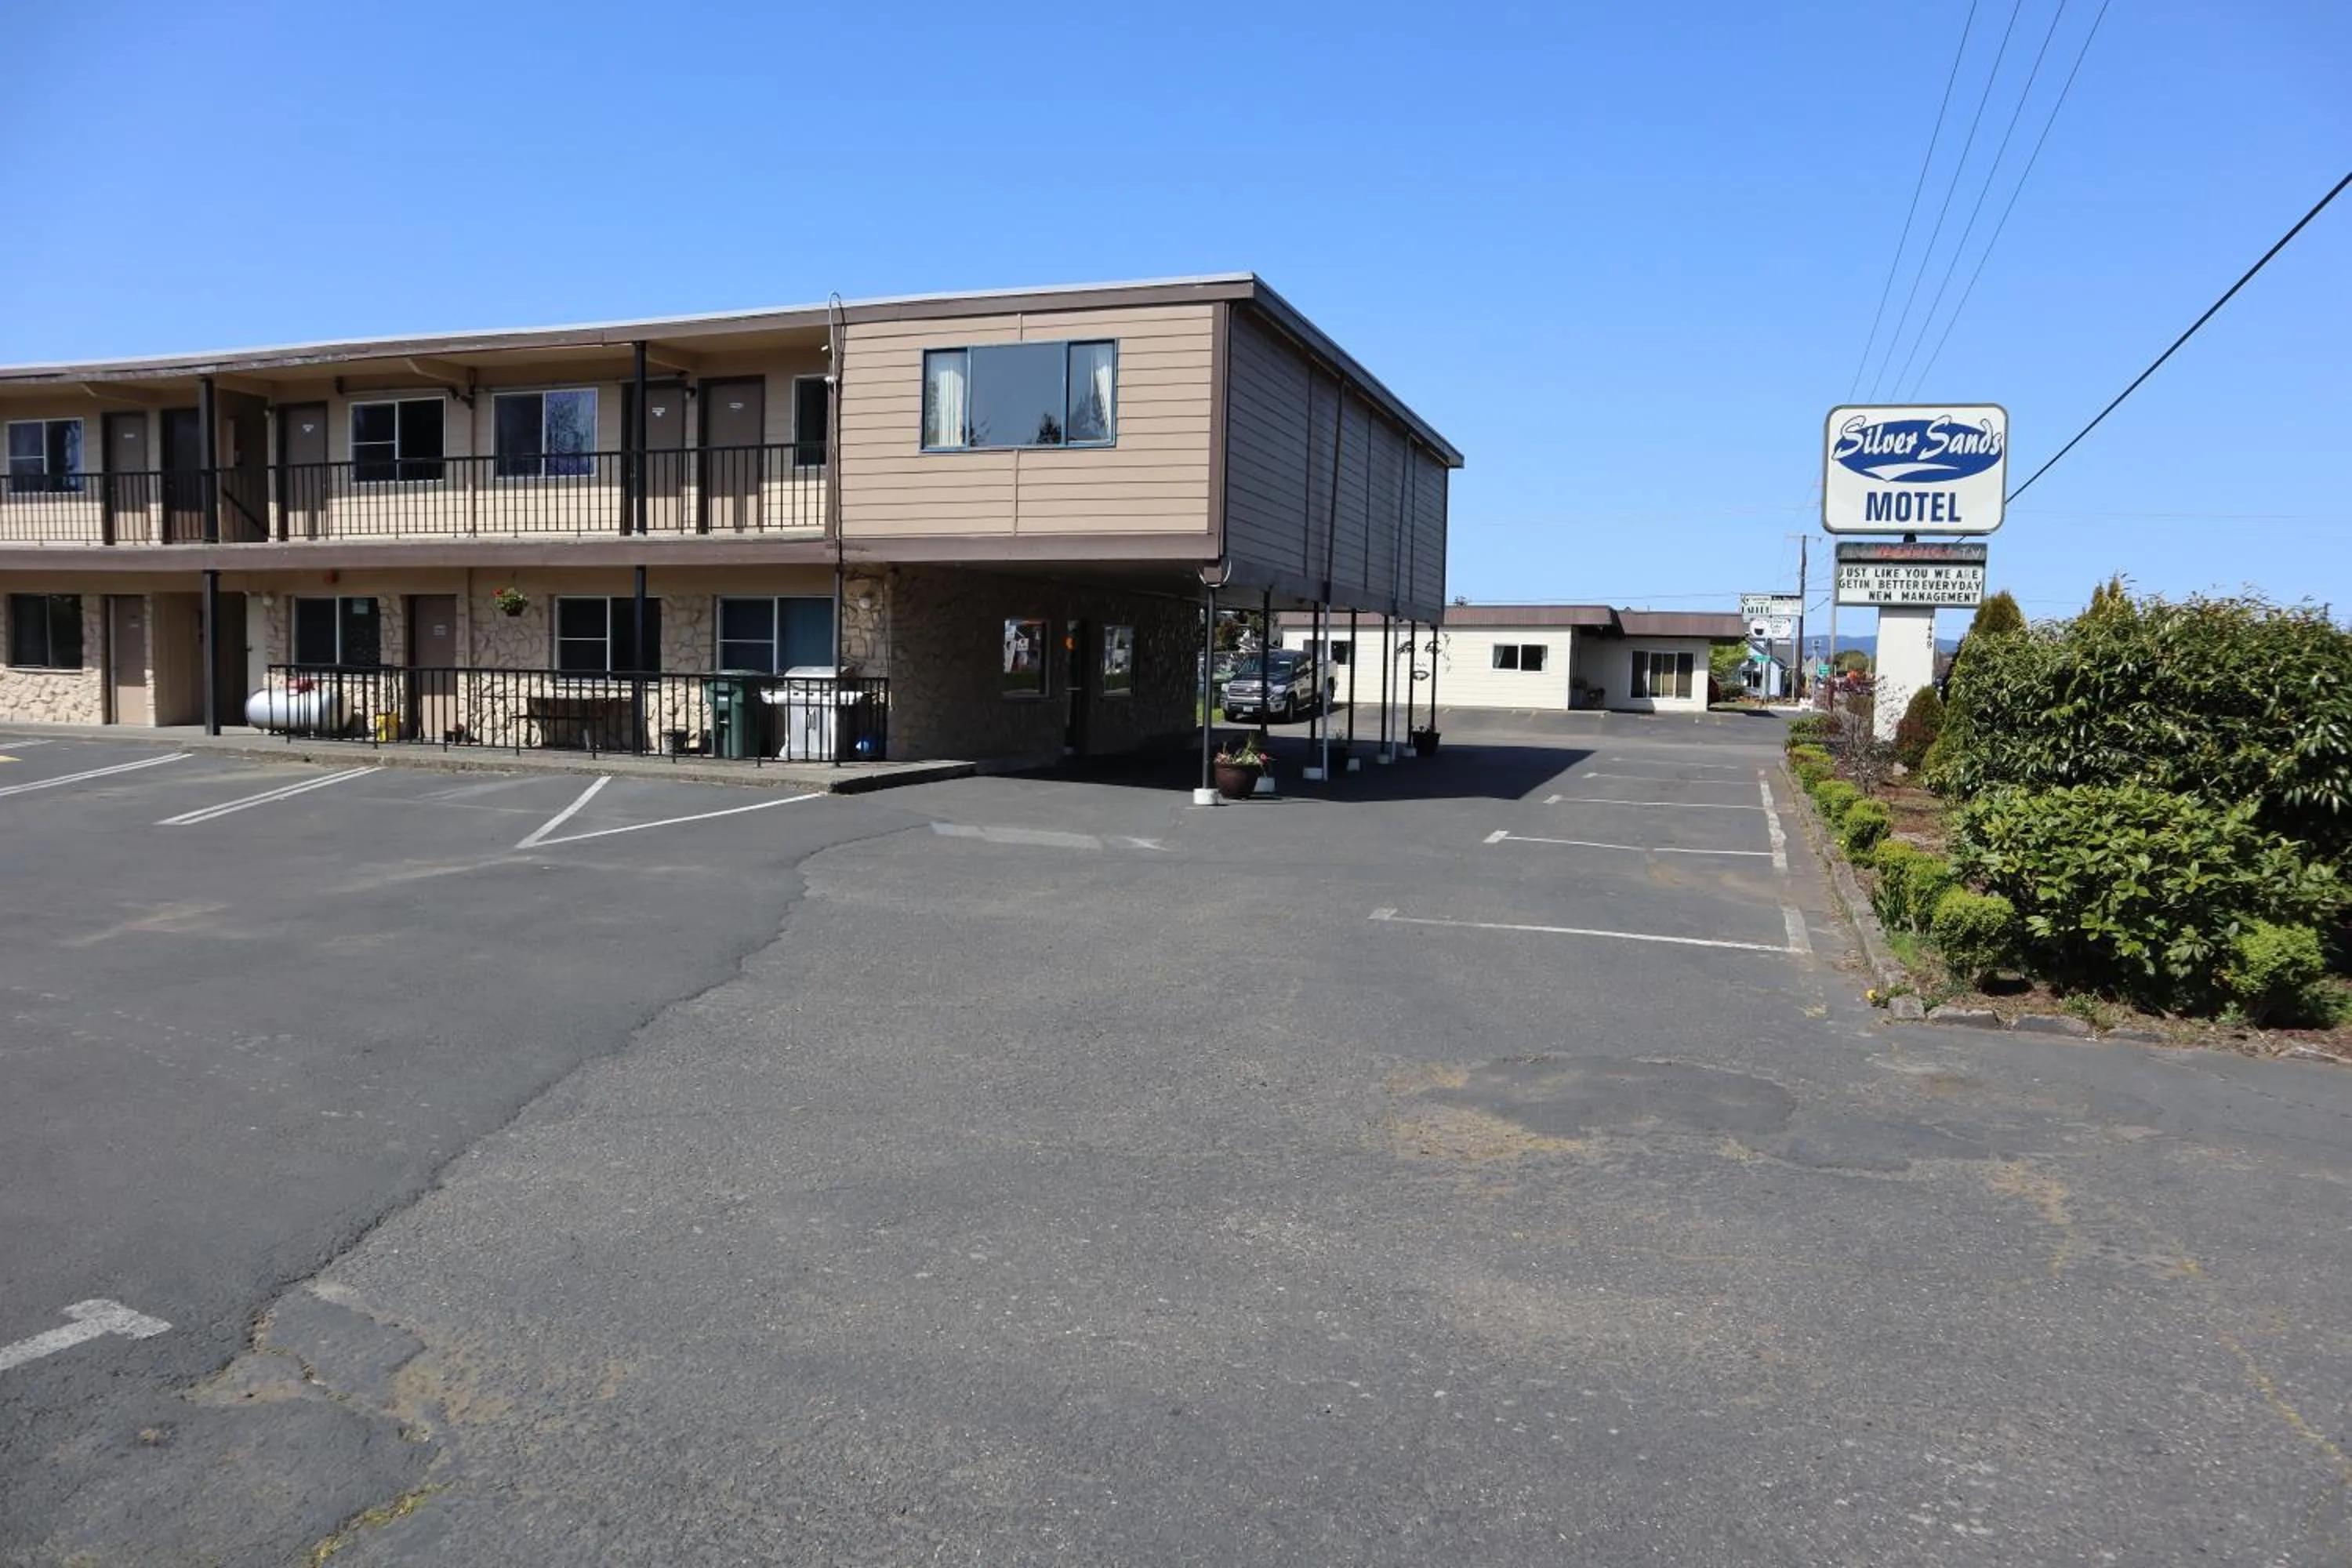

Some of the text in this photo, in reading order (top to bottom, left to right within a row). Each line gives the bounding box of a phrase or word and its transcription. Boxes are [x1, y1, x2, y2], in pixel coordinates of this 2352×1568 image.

[1831, 414, 2002, 461] Silver Sands
[1865, 492, 1962, 523] MOTEL
[1838, 568, 1866, 578] JUST
[1875, 568, 1900, 578] LIKE
[1905, 568, 1928, 579] YOU
[1934, 568, 1951, 579] WE
[1878, 579, 1920, 590] BETTER
[1922, 580, 1981, 590] EVERYDAY
[1901, 591, 1978, 603] MANAGEMENT
